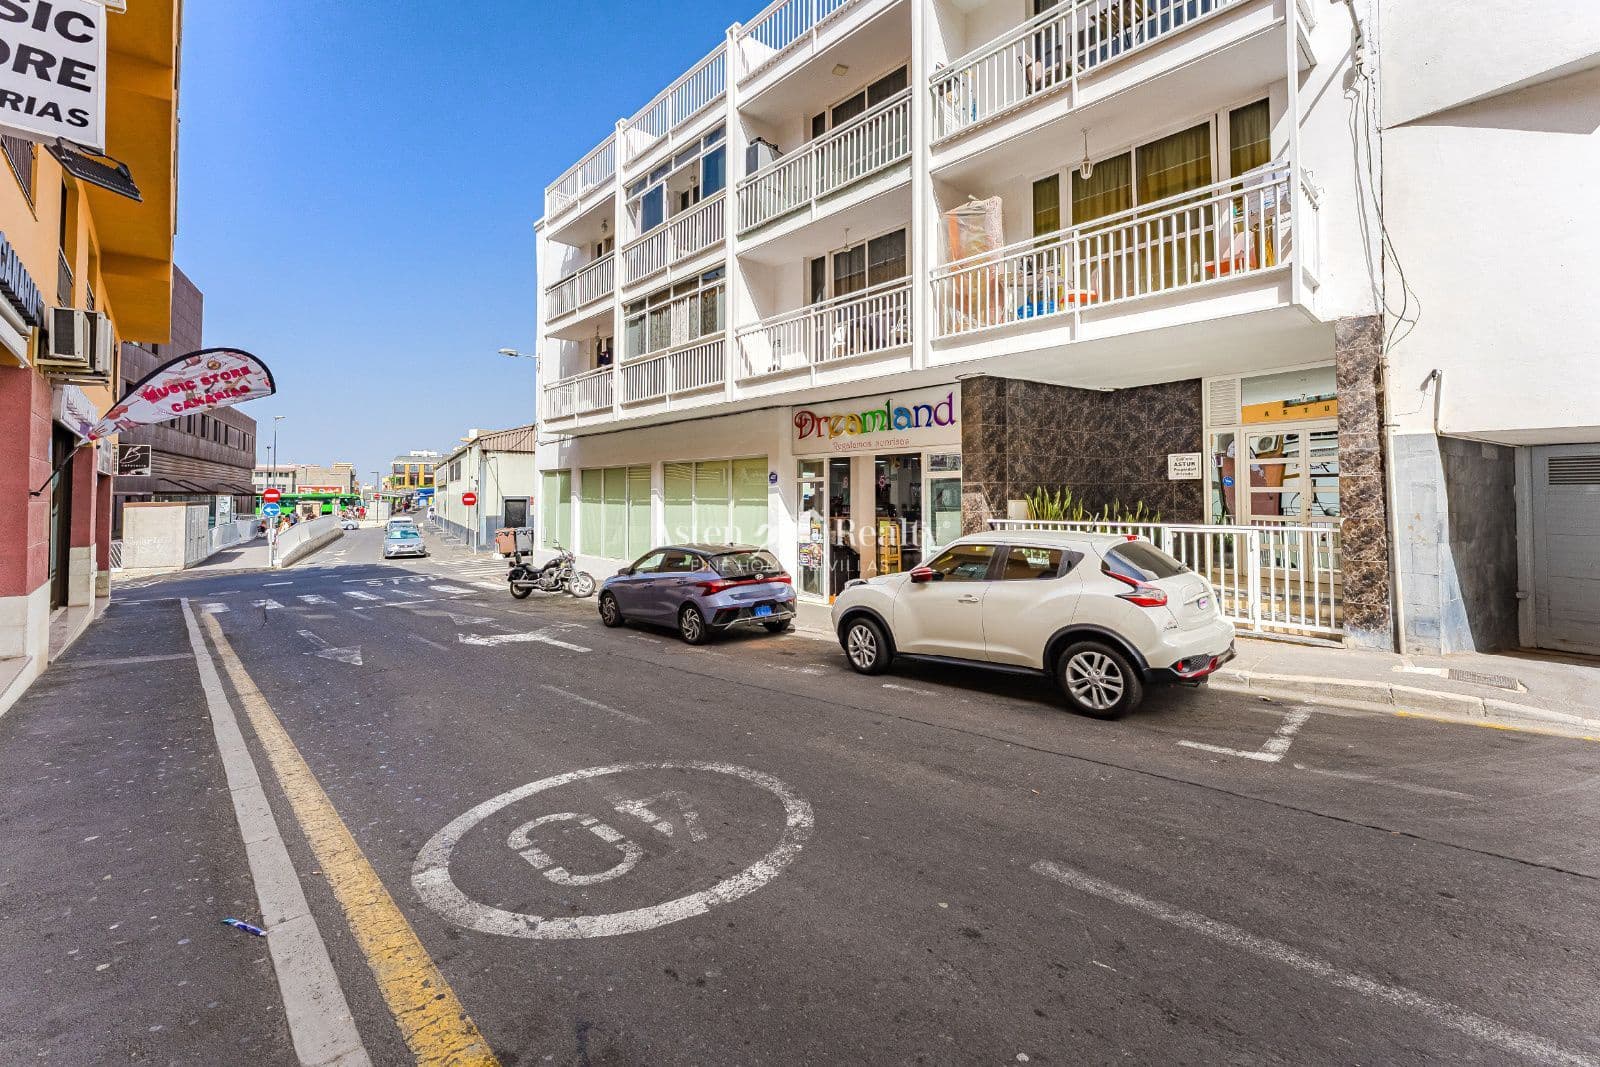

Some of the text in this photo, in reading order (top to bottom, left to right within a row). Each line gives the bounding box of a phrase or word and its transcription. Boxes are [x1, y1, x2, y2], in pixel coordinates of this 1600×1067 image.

[0, 38, 96, 92] RE
[142, 366, 251, 404] MUSIC STORE
[171, 385, 251, 413] CANARIAS
[794, 392, 956, 440] Dreamland
